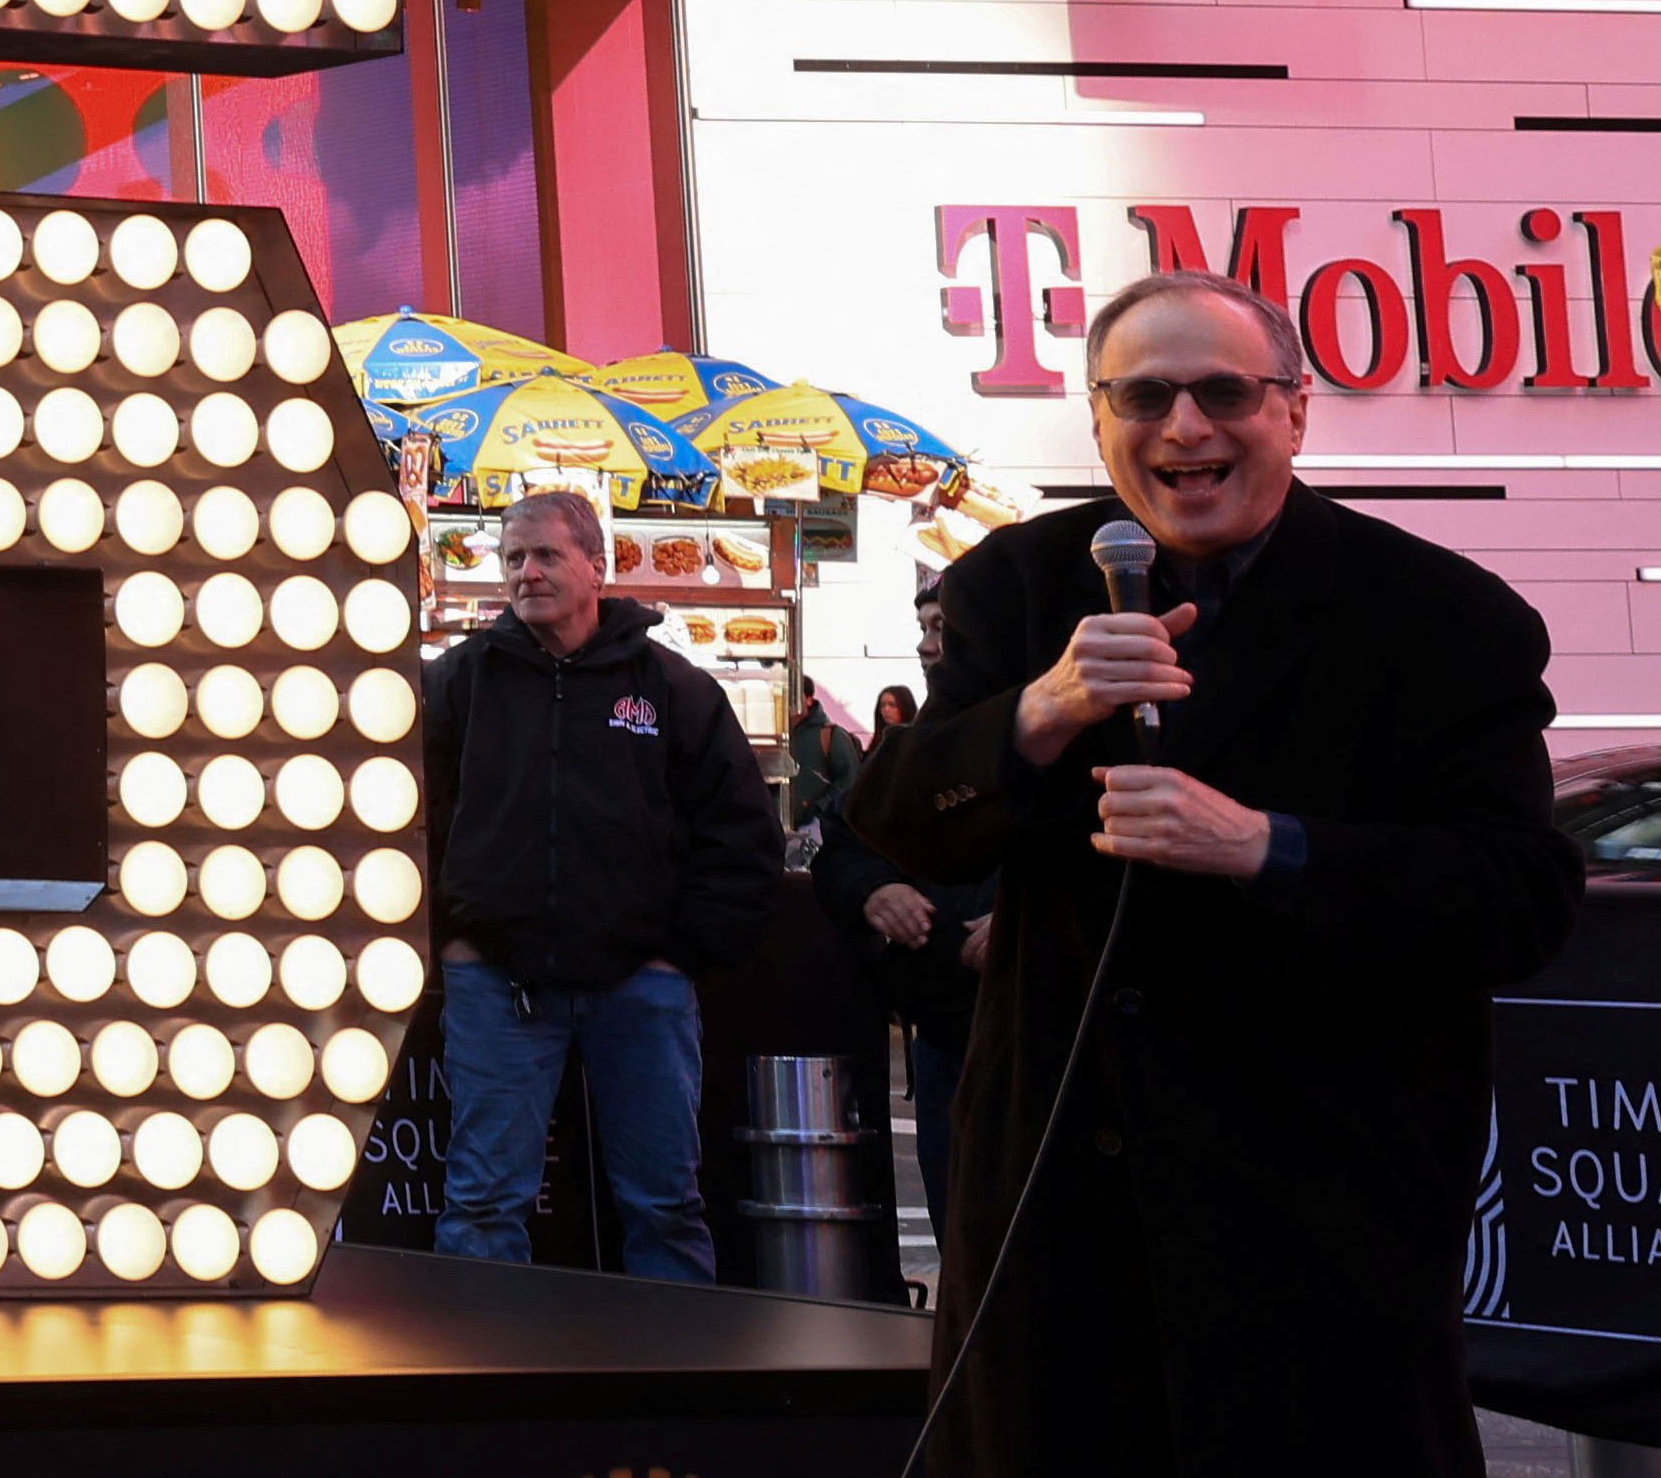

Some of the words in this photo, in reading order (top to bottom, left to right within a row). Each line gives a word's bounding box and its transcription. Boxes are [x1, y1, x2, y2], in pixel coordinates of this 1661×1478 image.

[935, 205, 1088, 396] T
[501, 418, 605, 445] SABRETT
[728, 416, 836, 434] SABRETT
[1529, 1146, 1661, 1204] SQU
